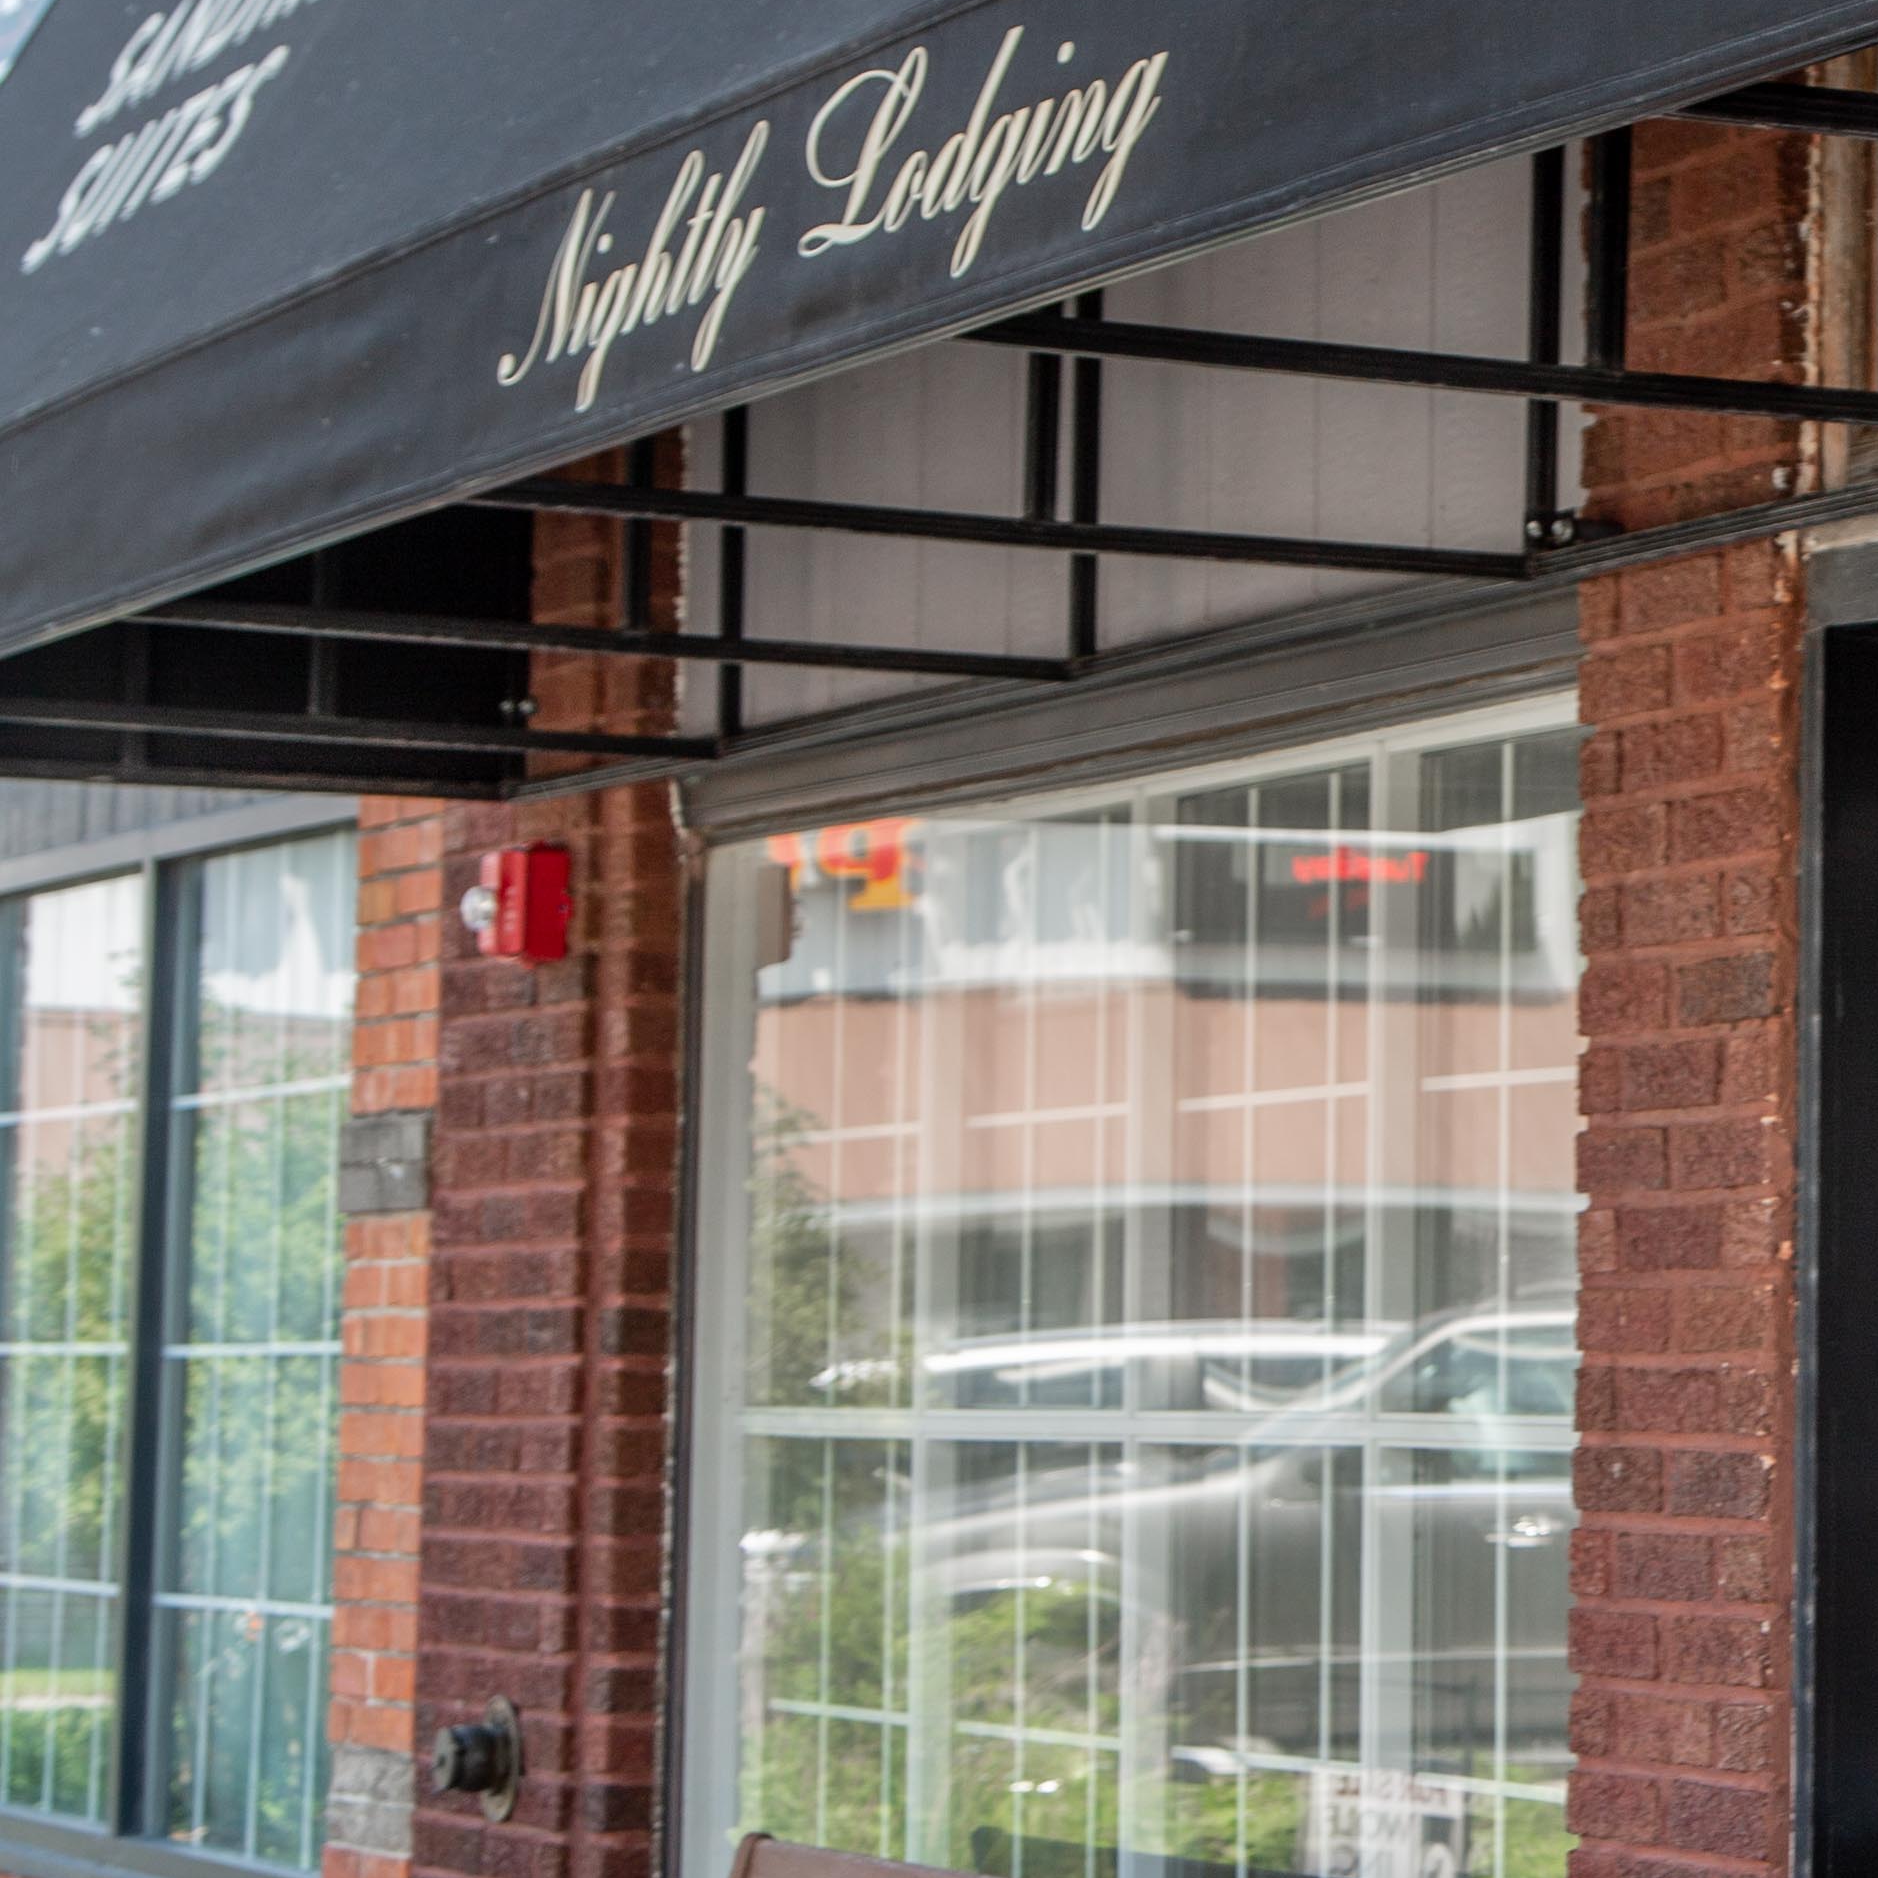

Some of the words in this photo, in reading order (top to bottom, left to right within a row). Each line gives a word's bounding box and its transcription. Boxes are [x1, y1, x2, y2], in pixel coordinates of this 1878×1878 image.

[21, 43, 291, 274] SUITES
[498, 120, 769, 412] Nightly
[798, 25, 1170, 278] Lodging
